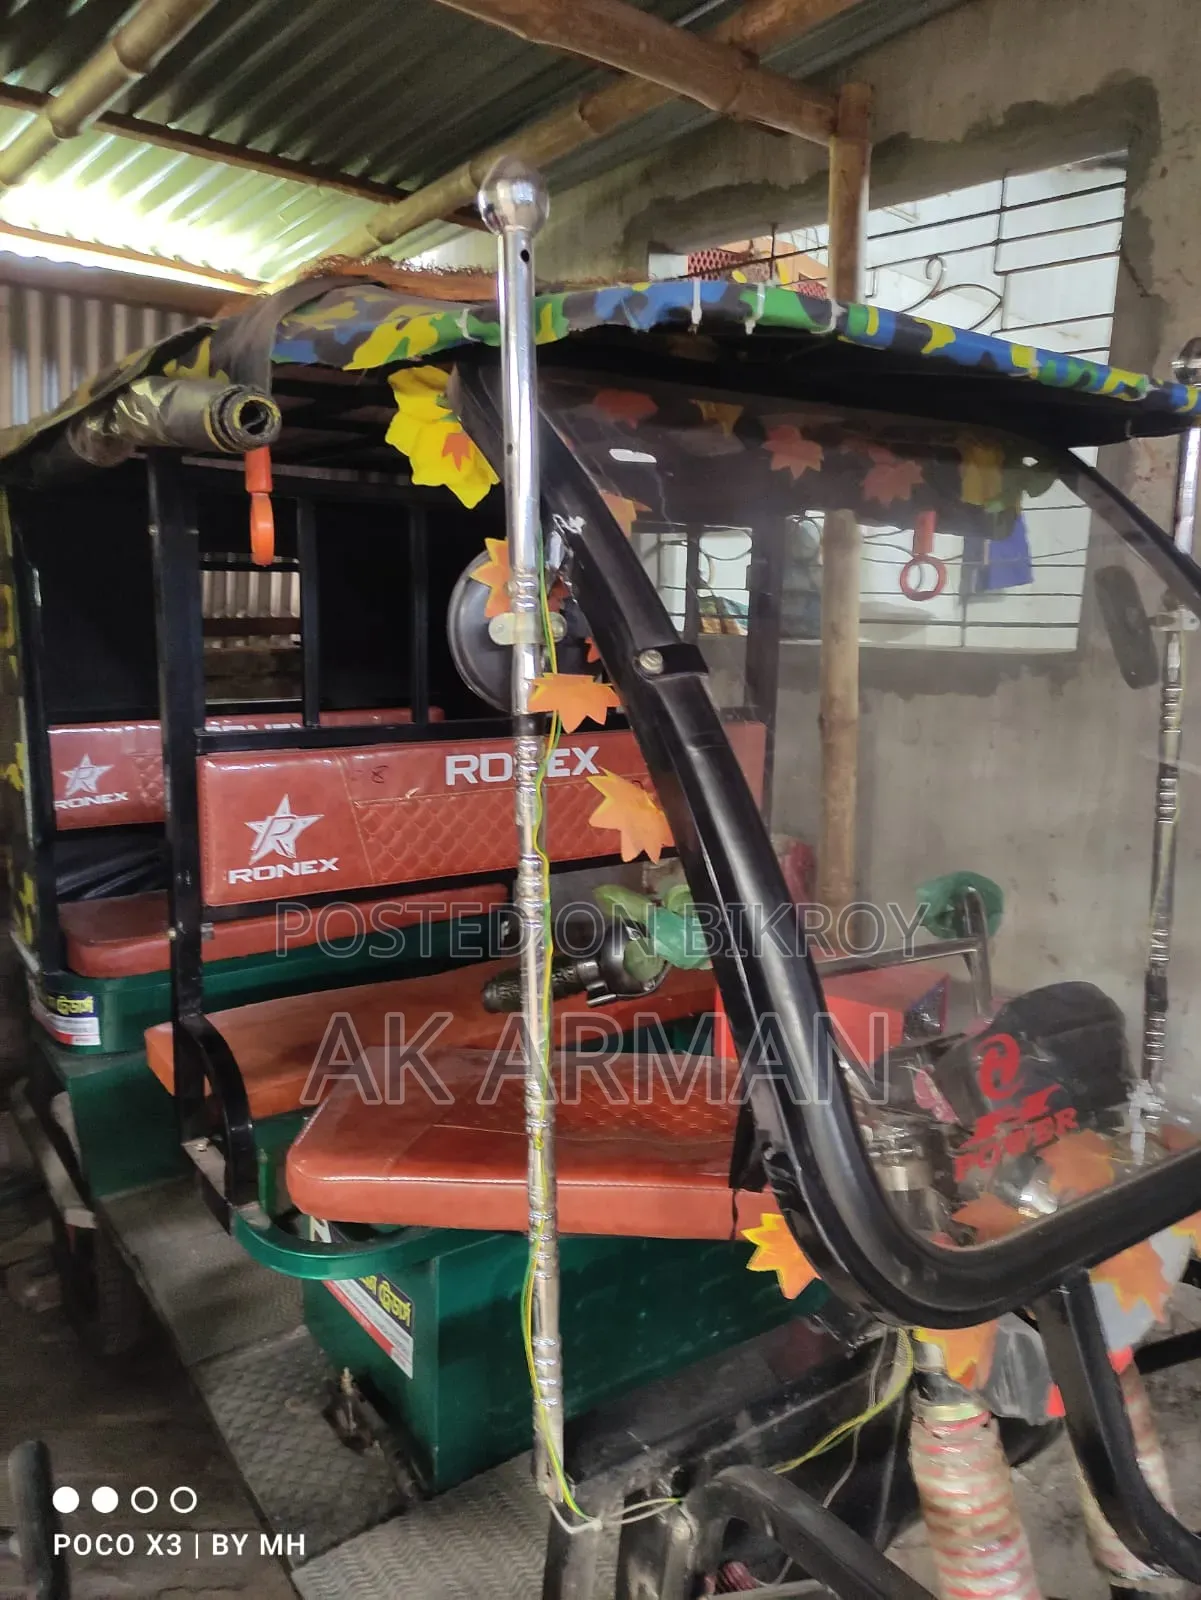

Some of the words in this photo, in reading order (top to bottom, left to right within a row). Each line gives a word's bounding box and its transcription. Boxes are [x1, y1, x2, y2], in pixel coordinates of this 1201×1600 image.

[445, 746, 600, 786] ROEX
[54, 791, 129, 810] RONEX
[228, 857, 339, 885] RONEX
